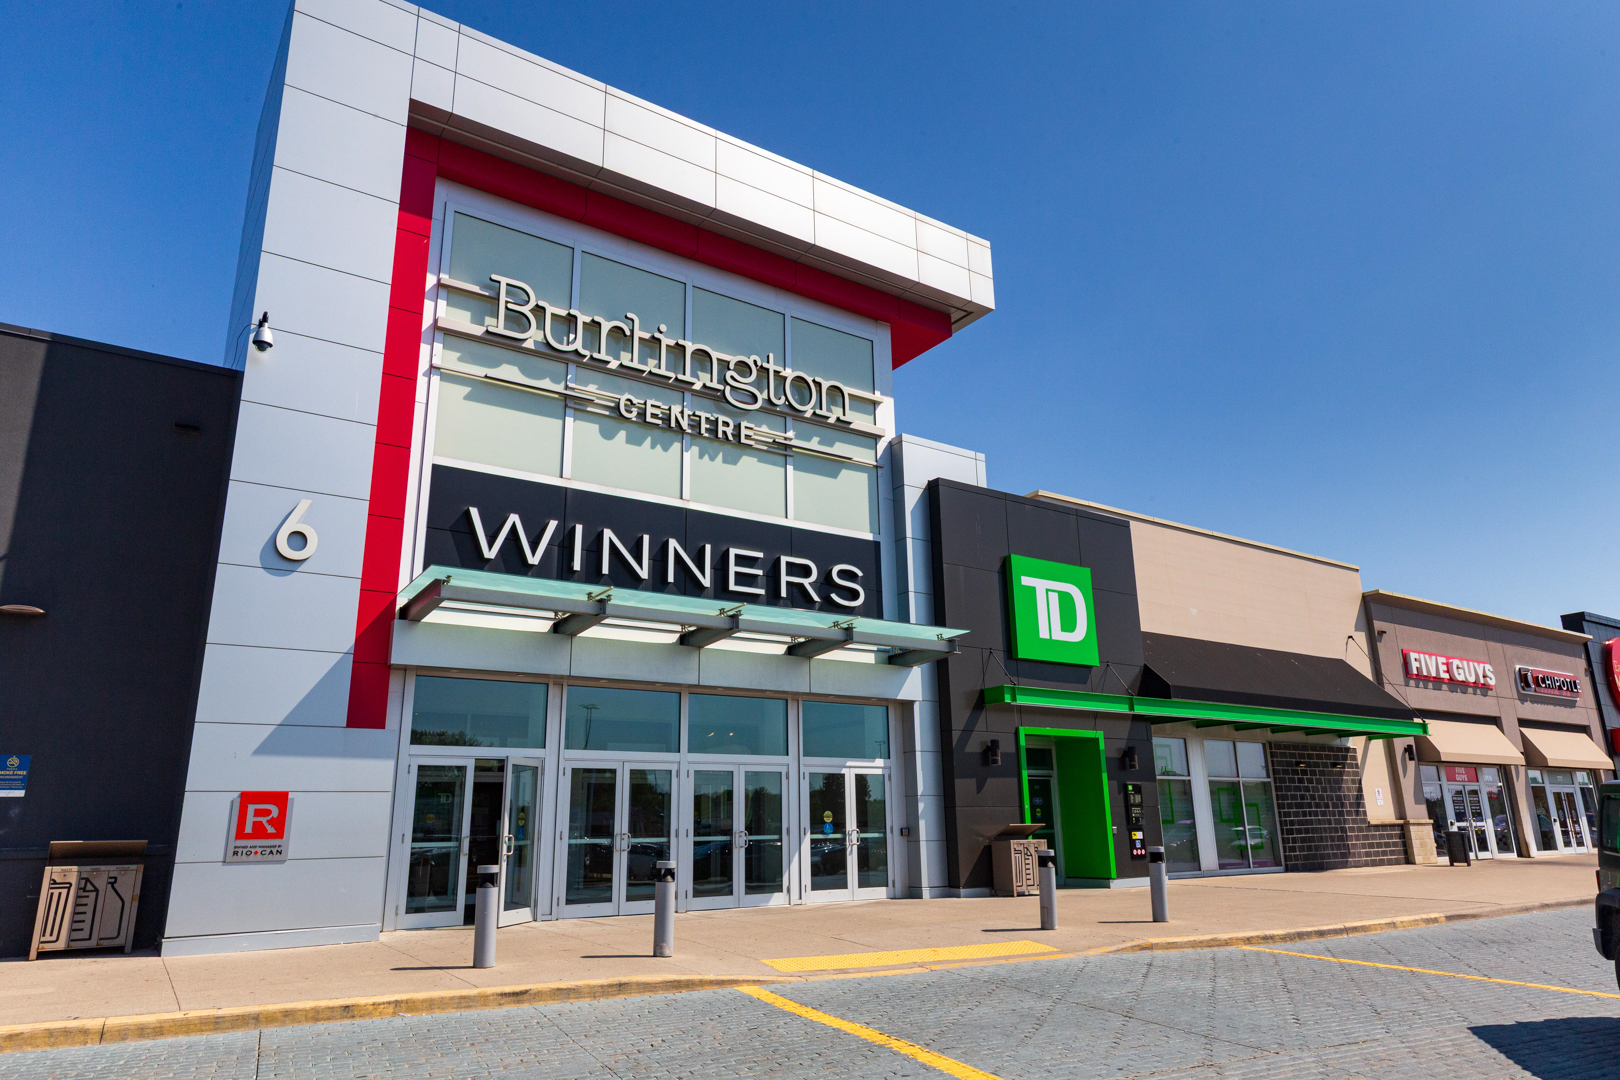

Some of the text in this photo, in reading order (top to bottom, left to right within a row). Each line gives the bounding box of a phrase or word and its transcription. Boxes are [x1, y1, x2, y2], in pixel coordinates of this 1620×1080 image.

[486, 273, 855, 423] Burlington
[617, 394, 756, 446] CENTRE
[275, 498, 318, 561] 6
[468, 506, 866, 608] WINNERS
[1020, 575, 1088, 643] TD
[1406, 651, 1496, 686] FIVE GUYS
[1537, 673, 1583, 693] CHIPOTLE
[1455, 774, 1468, 782] GUYS
[243, 804, 279, 833] R
